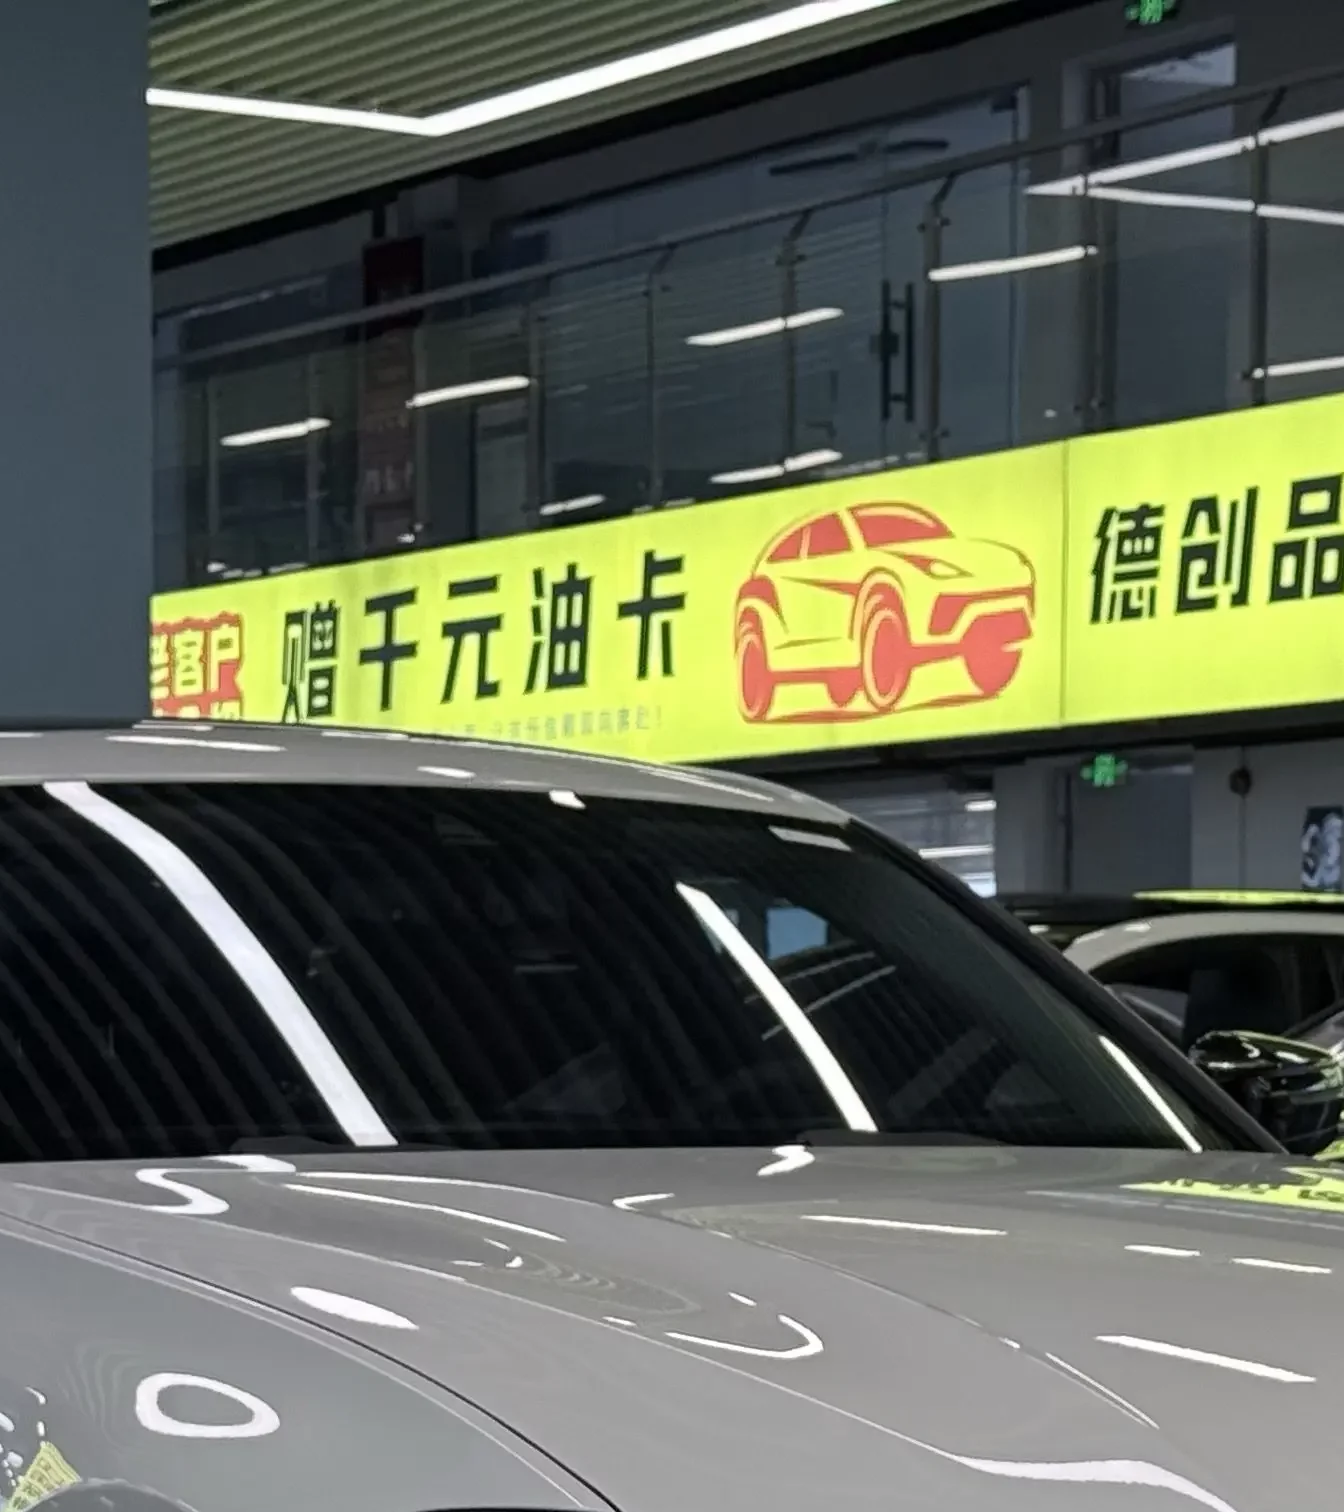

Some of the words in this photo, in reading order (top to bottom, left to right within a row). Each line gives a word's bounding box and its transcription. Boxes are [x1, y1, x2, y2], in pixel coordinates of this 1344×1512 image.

[279, 550, 687, 725] 赠千元油卡
